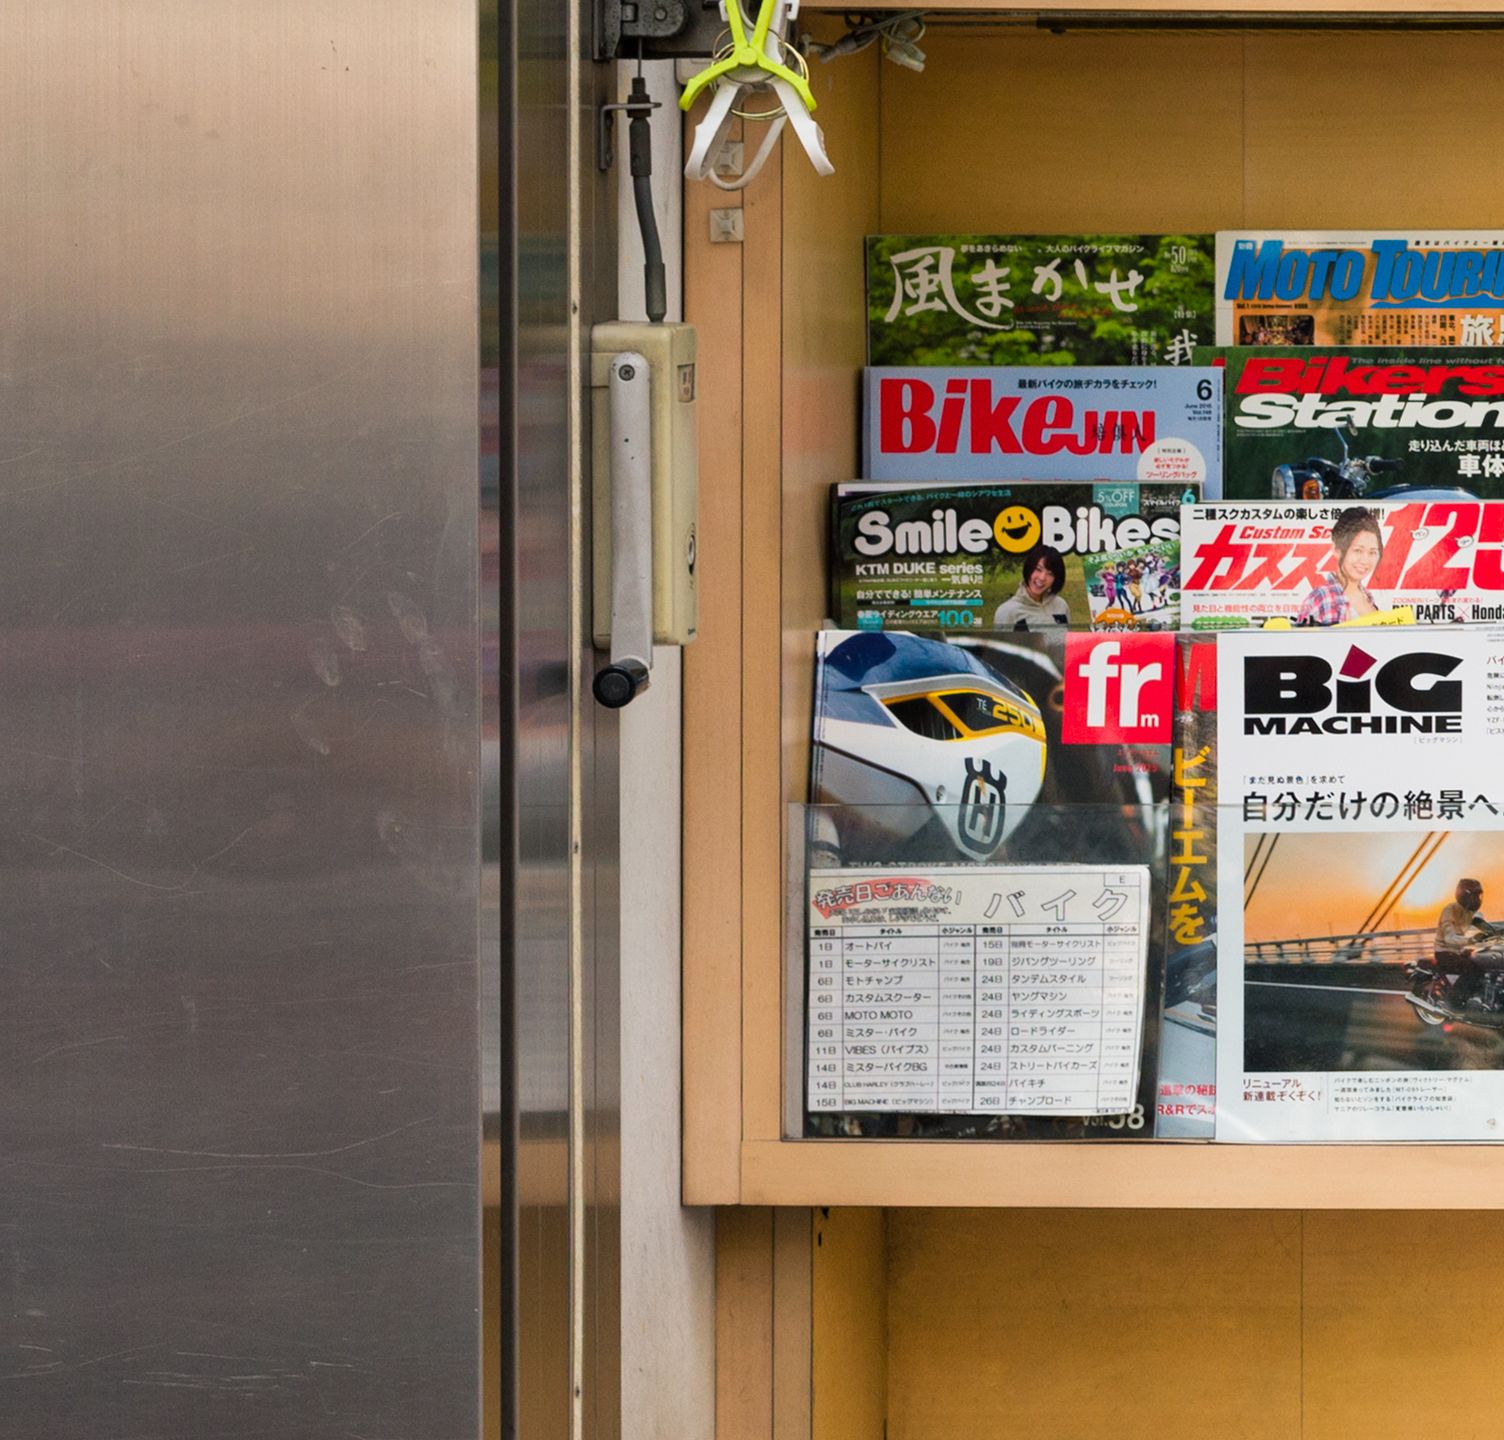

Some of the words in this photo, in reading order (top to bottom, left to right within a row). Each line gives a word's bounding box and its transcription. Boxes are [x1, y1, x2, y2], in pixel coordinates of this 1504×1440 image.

[1223, 239, 1365, 301] MOTO
[884, 246, 1144, 331] 風まかせ
[854, 505, 994, 556] Smile
[1042, 505, 1181, 555] Bikes
[855, 562, 889, 576] KTM
[894, 562, 936, 575] DUKE
[939, 564, 983, 575] series
[1416, 604, 1455, 620] PARTS
[1244, 715, 1463, 735] MACHINE
[1011, 992, 1067, 1001] ヤングマシン
